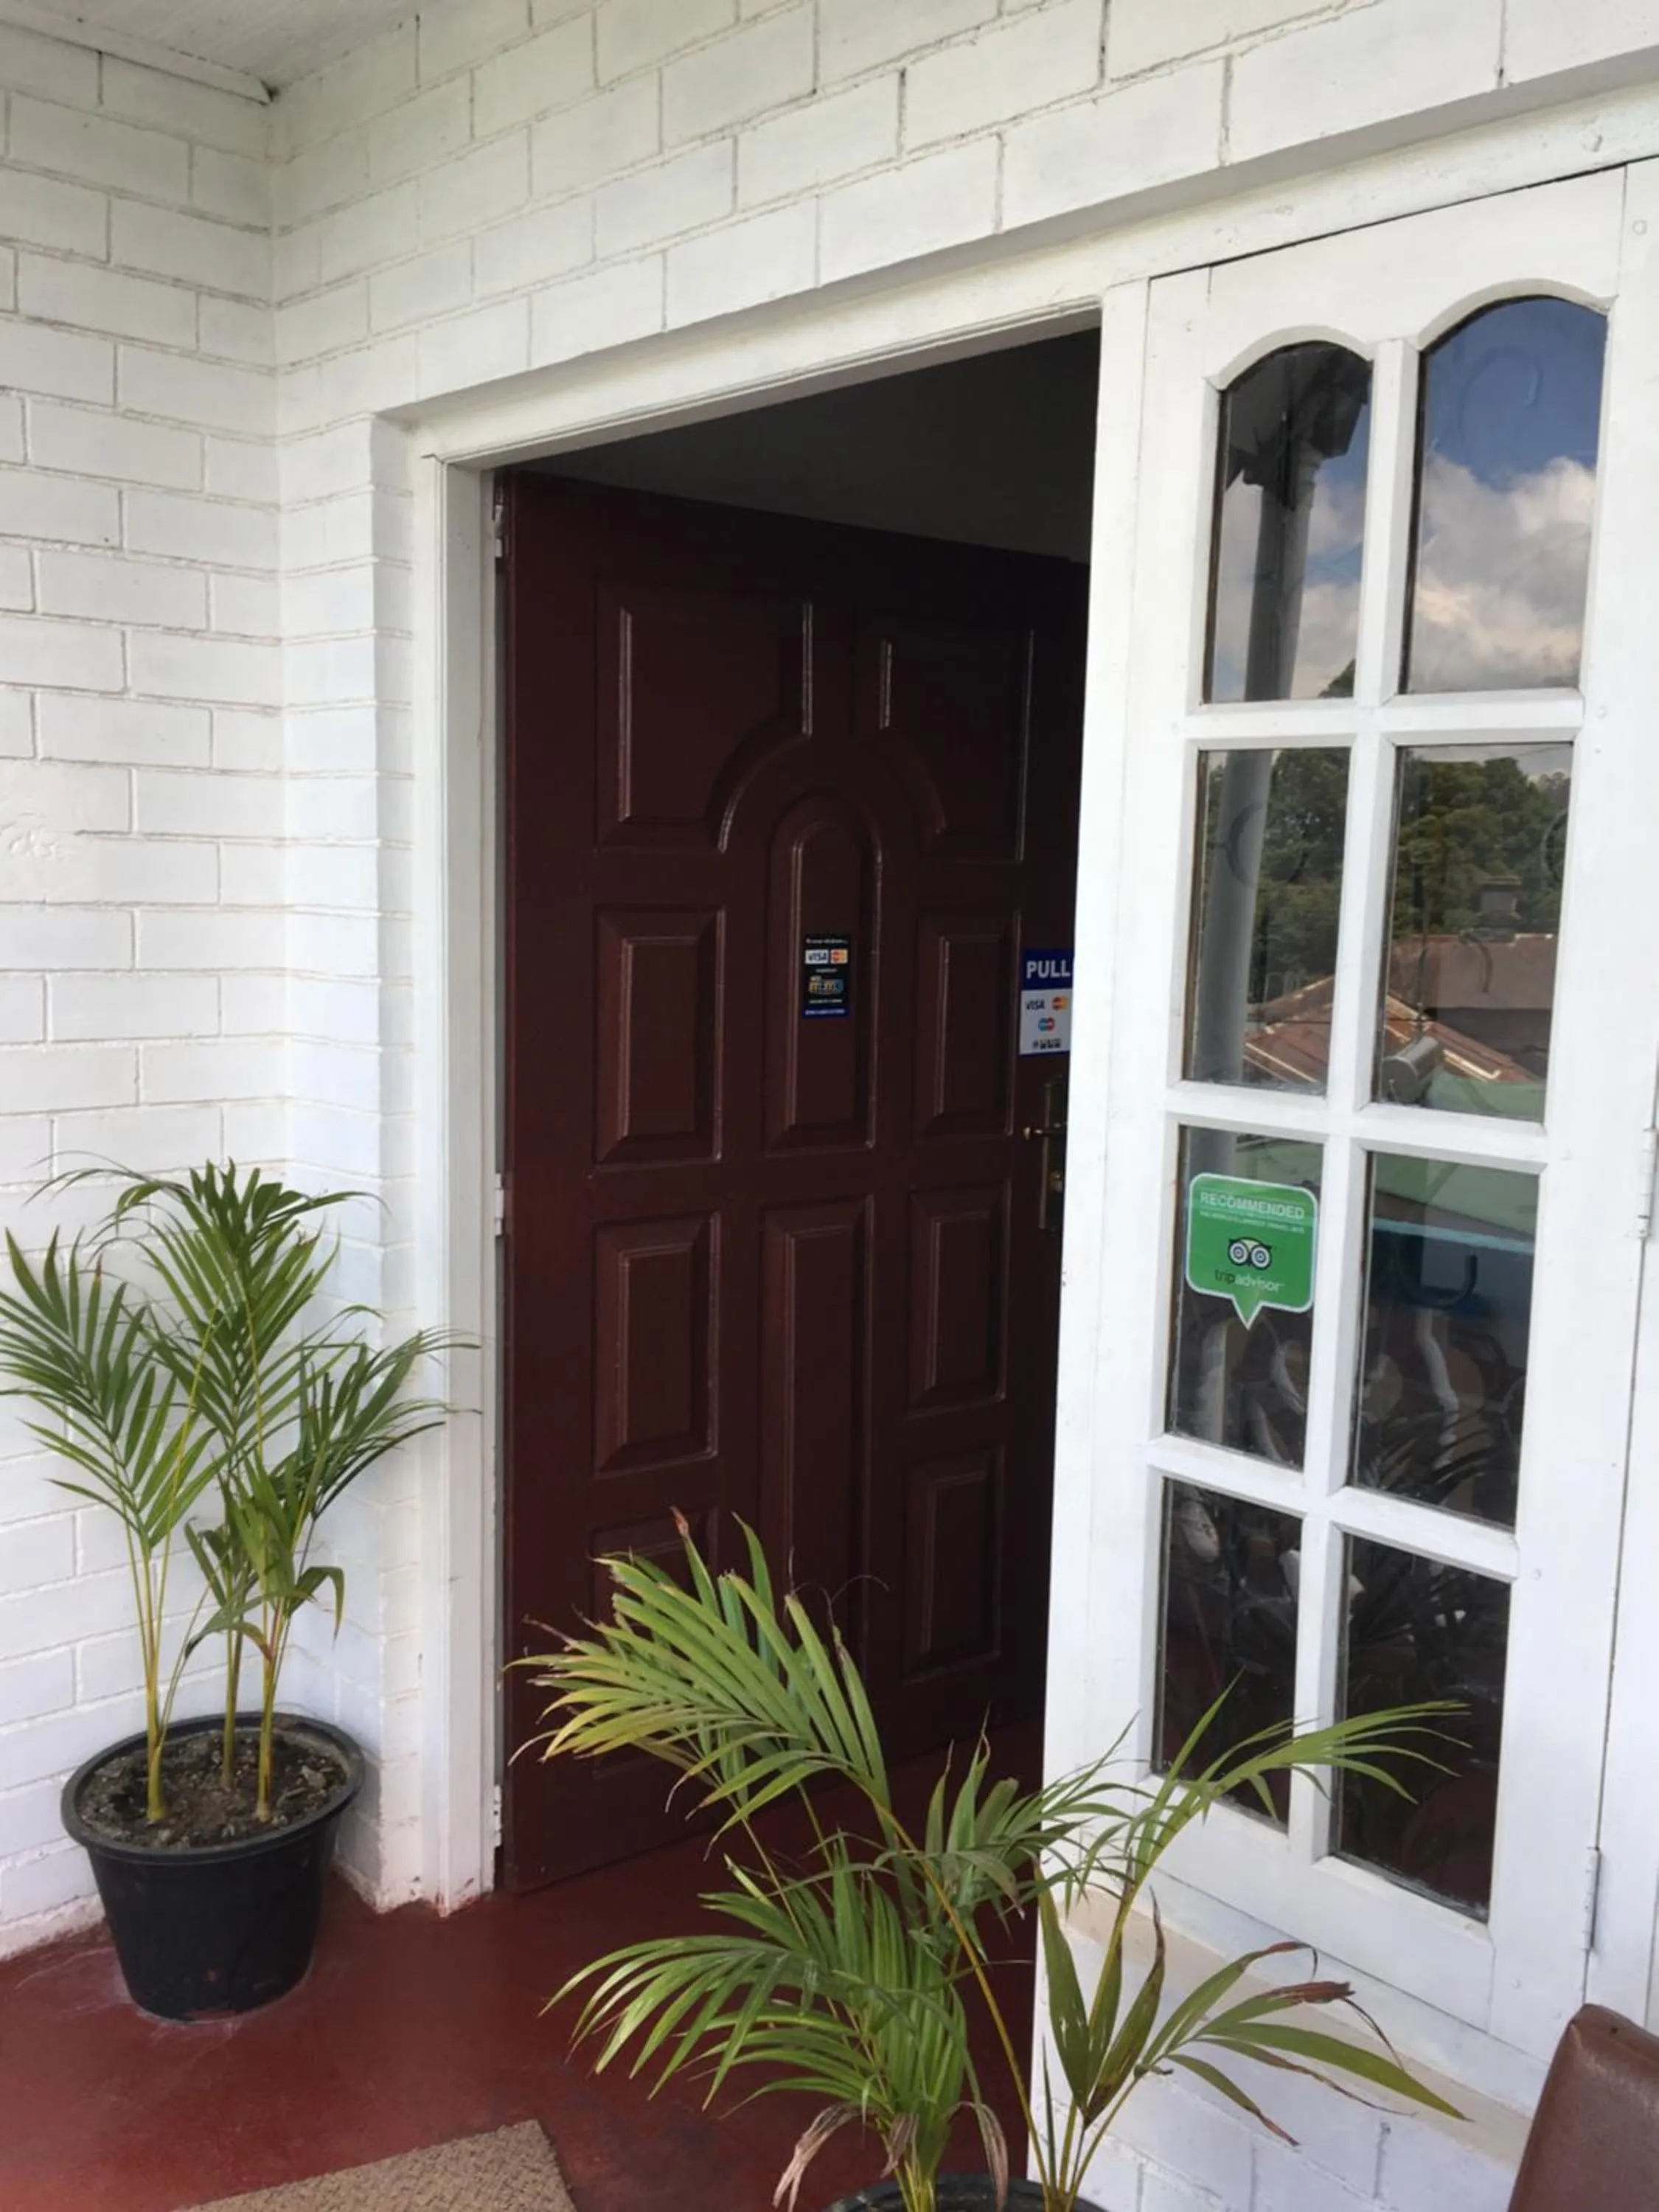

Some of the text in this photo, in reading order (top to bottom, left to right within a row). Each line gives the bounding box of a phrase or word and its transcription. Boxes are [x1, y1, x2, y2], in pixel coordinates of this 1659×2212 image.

[1026, 960, 1071, 979] PULL
[1026, 998, 1046, 1011] VISA
[1200, 1191, 1305, 1219] RECOMMENDED
[1214, 1269, 1281, 1293] tripadvisor
